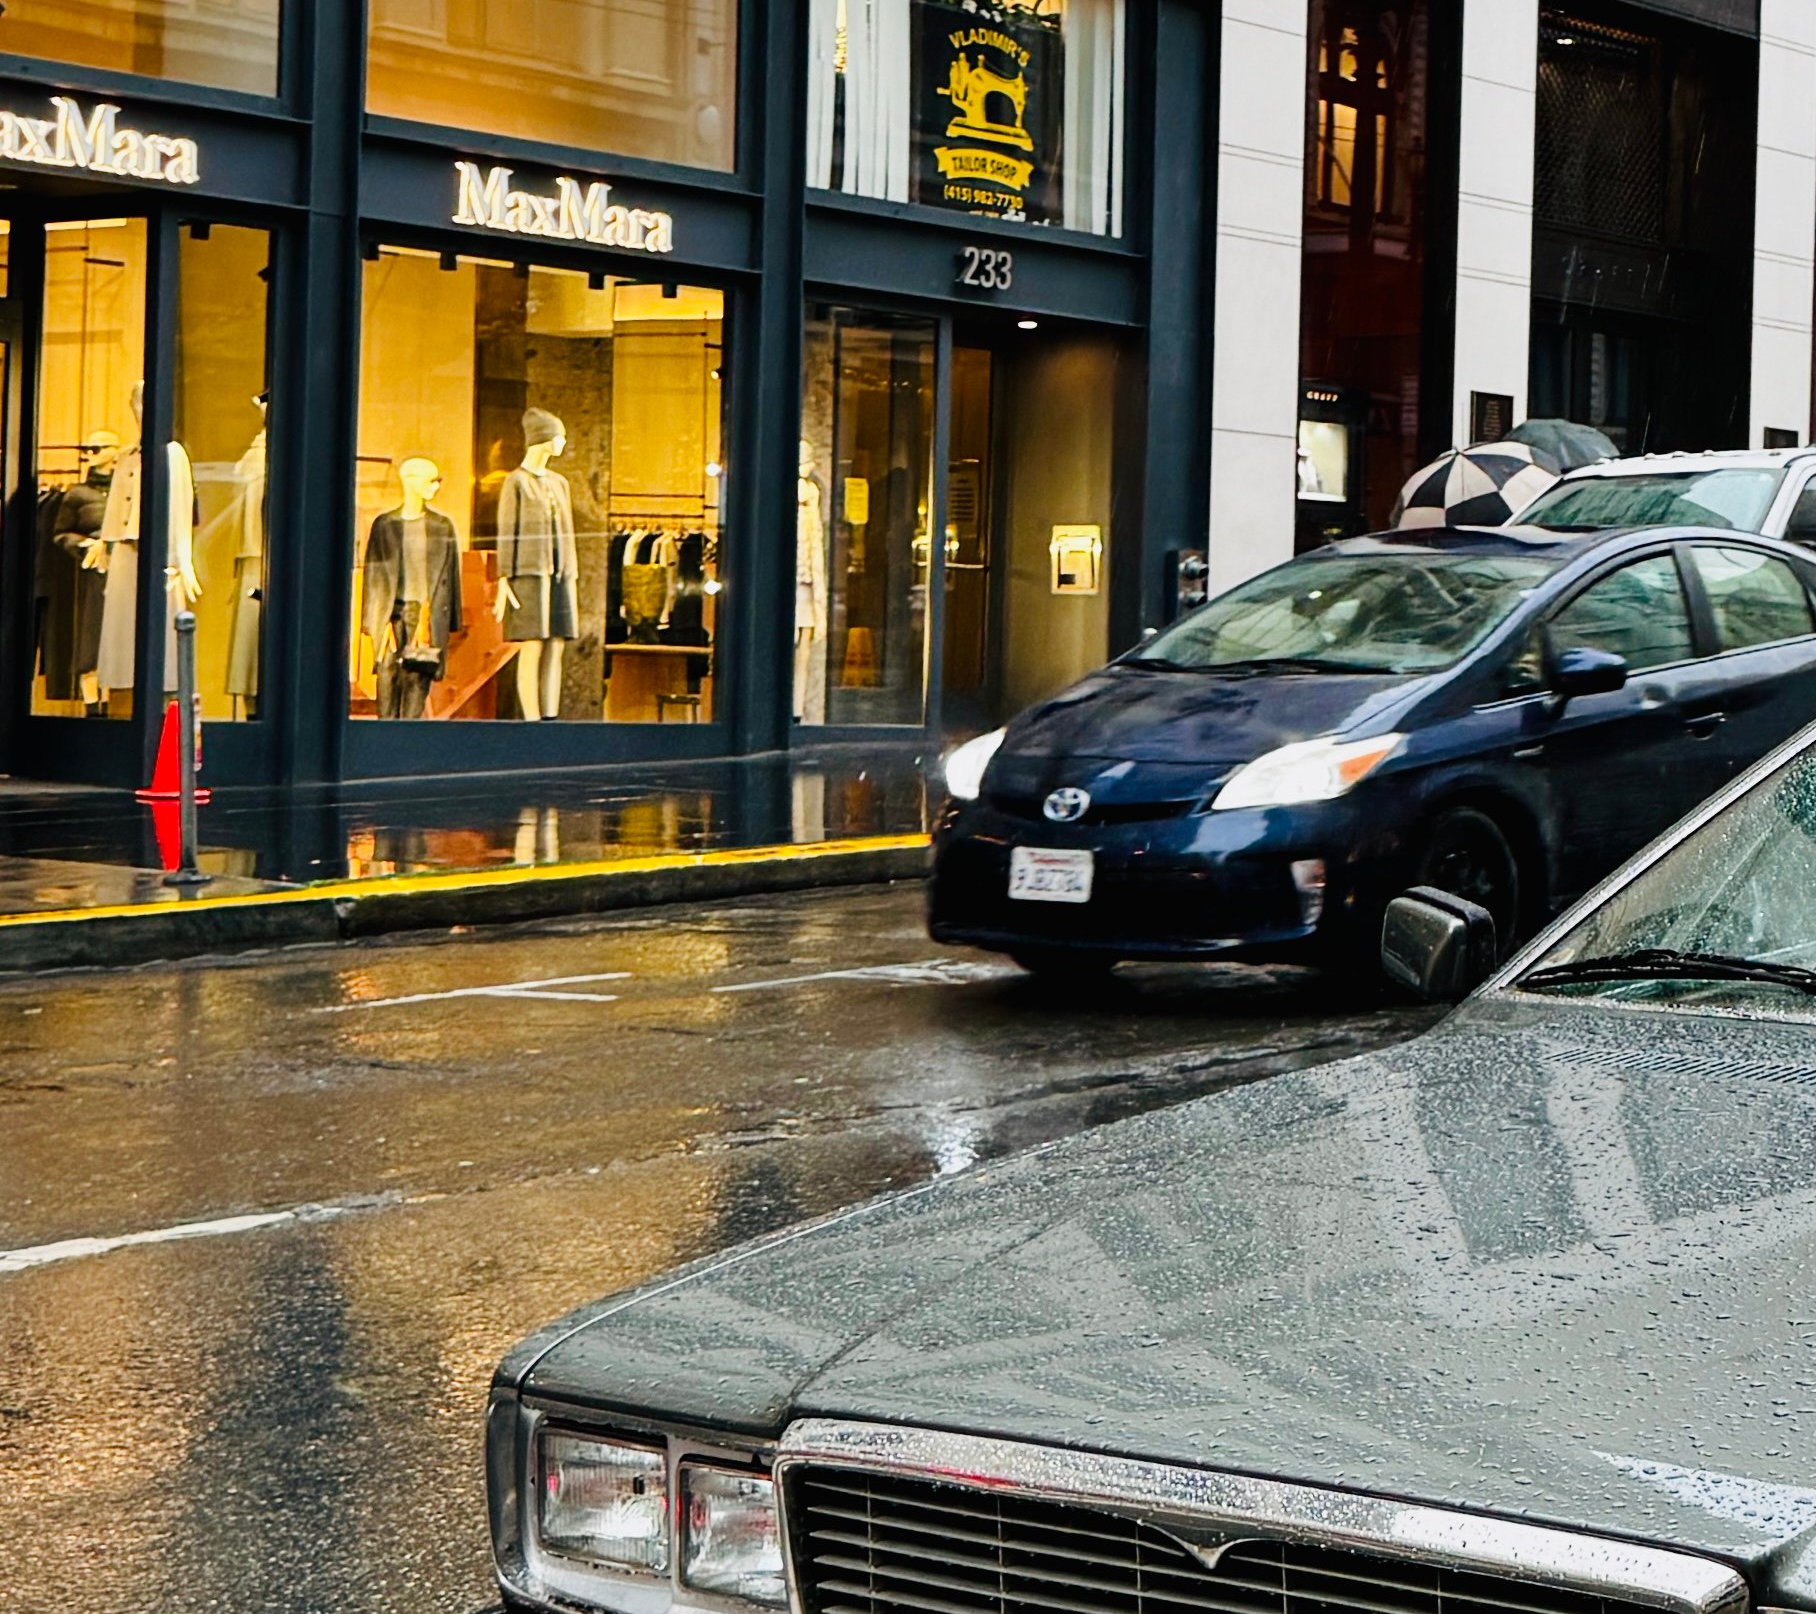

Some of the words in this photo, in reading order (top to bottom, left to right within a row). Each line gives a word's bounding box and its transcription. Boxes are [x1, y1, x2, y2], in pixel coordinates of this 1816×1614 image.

[949, 27, 1031, 67] VLADIMIR'S
[0, 97, 200, 184] axMara
[951, 156, 988, 175] TAILOR
[990, 159, 1017, 180] SHOP
[453, 161, 673, 253] MaxMara
[944, 184, 972, 203] (415)
[963, 246, 1013, 290] 233
